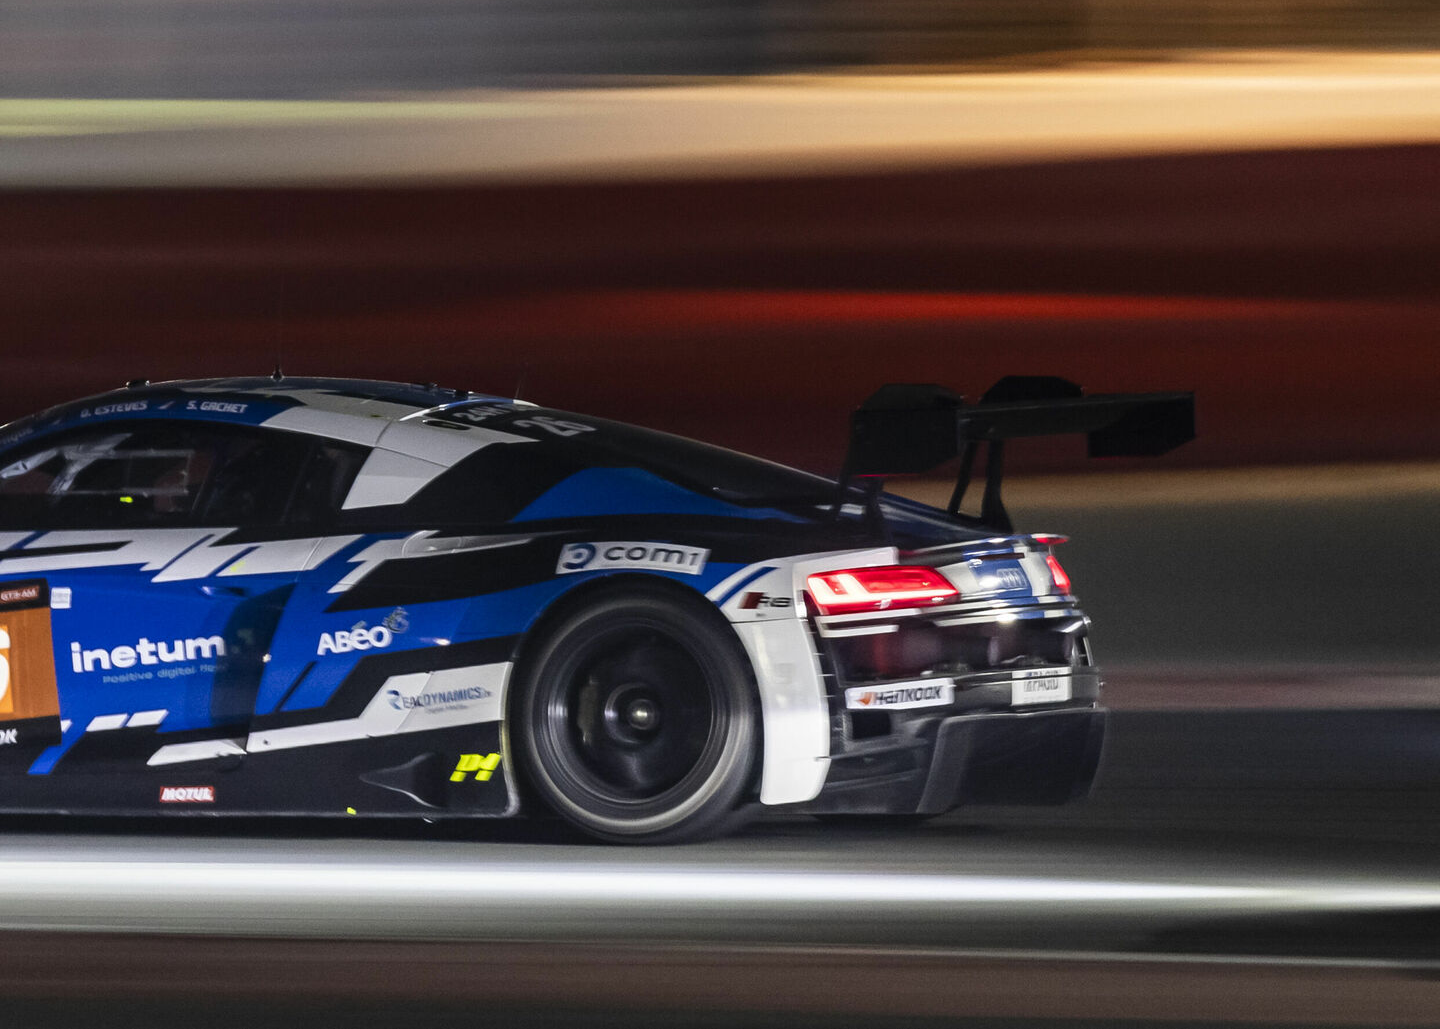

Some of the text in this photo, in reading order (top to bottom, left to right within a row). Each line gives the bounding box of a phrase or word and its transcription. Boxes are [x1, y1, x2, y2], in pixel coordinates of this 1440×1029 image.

[94, 400, 149, 416] ESTEVES
[185, 400, 249, 414] S. GACHET
[512, 416, 599, 437] 26
[69, 634, 229, 674] inetum
[102, 669, 154, 684] Positive
[157, 665, 197, 680] digital
[161, 787, 213, 802] MOTUL
